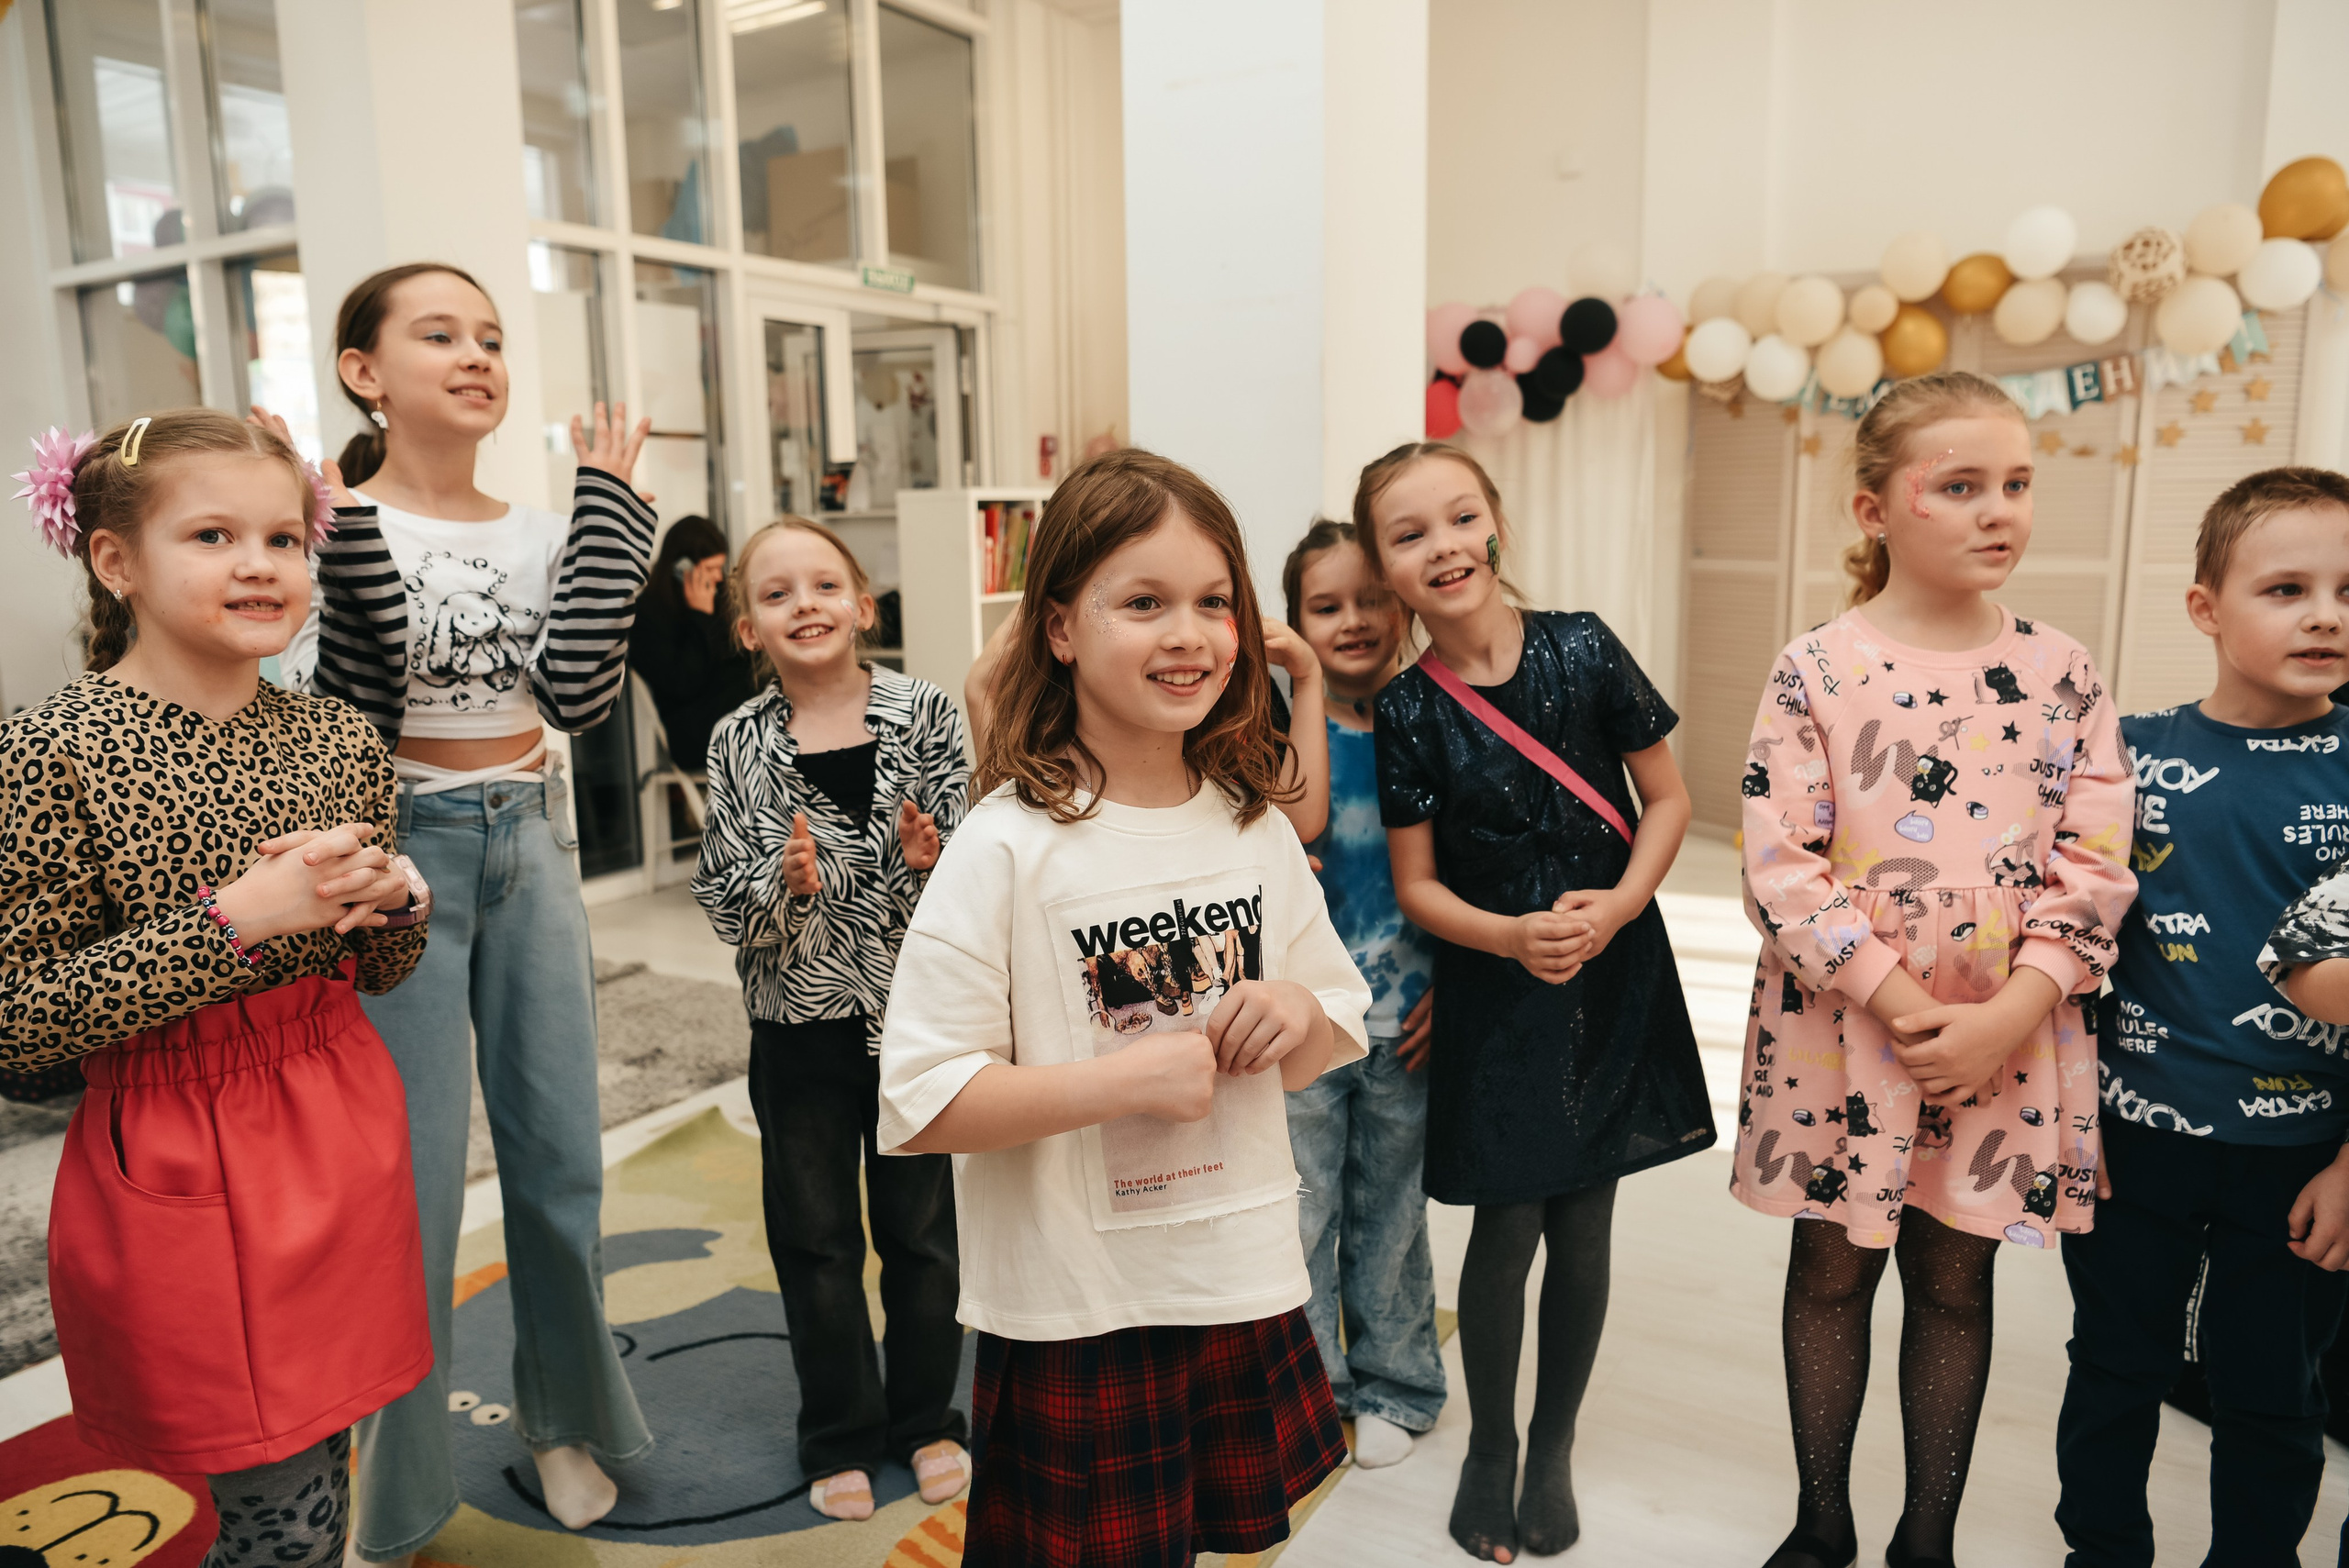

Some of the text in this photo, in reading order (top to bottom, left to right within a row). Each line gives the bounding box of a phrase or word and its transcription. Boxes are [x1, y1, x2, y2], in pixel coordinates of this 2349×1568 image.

[2030, 759, 2066, 781] JUST
[2299, 804, 2349, 820] HERE
[1071, 884, 1262, 958] weekend
[2143, 911, 2210, 937] XTRA
[2025, 918, 2074, 934] GOOD
[2074, 929, 2113, 951] DAYS
[1824, 940, 1856, 974] JUST
[2159, 942, 2199, 963] UN
[2121, 1000, 2145, 1017] NO
[2118, 1037, 2157, 1054] HERE
[2253, 1074, 2313, 1092] FUN
[2238, 1090, 2332, 1118] EXTRA
[1114, 1162, 1224, 1189] The world at their feet
[1115, 1184, 1167, 1197] Kathy Acker
